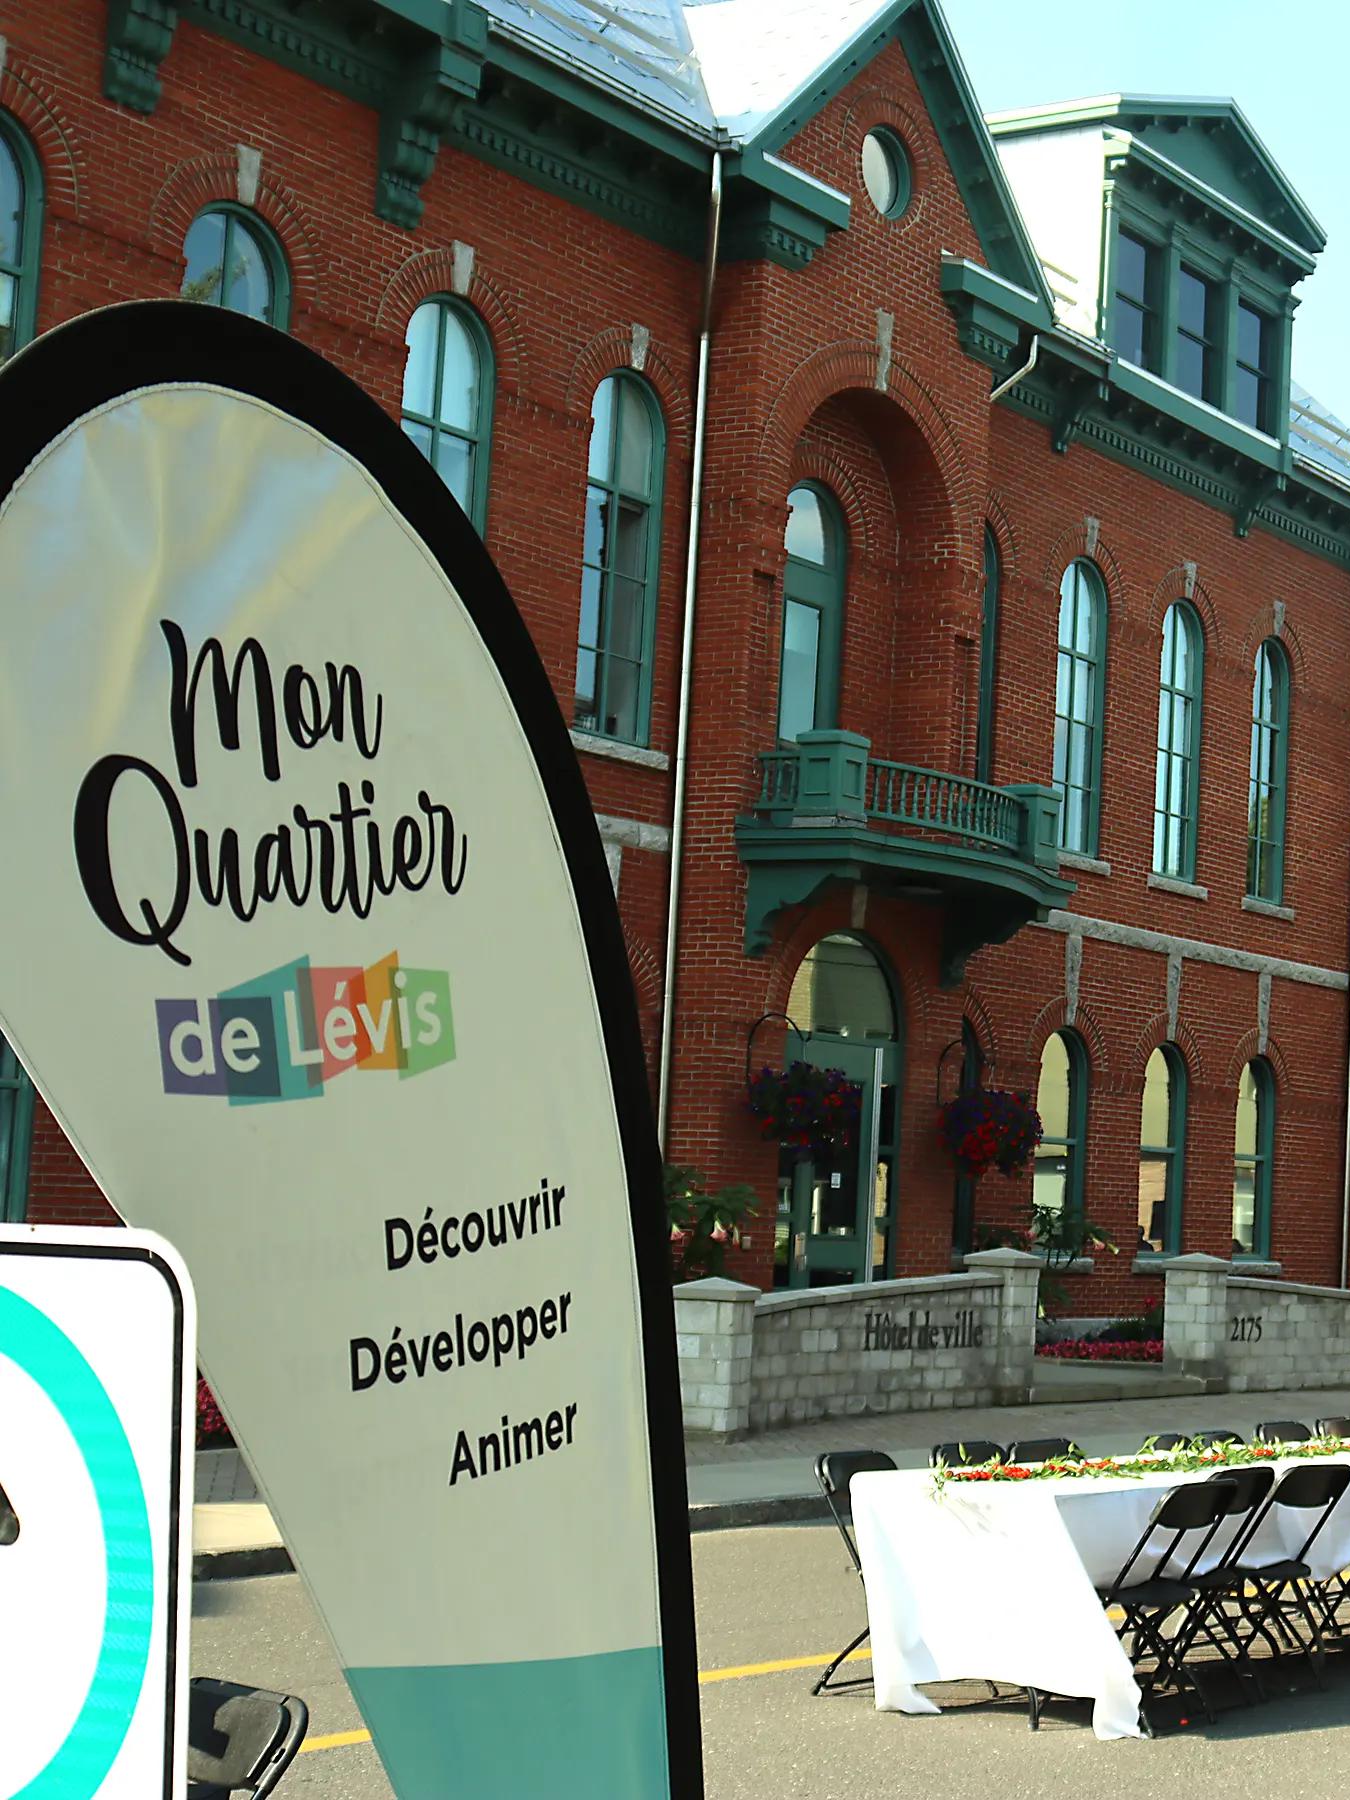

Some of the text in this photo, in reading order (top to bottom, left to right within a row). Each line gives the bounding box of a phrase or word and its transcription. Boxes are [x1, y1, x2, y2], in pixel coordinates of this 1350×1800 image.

[160, 619, 383, 788] Mon
[74, 753, 468, 967] Quartier
[169, 970, 442, 1077] de Lévis
[385, 1178, 566, 1271] Découvrir
[350, 1292, 571, 1392] Développer
[863, 1310, 983, 1351] Hôtel de ville
[1230, 1316, 1262, 1343] 2175
[449, 1402, 577, 1486] Animer
